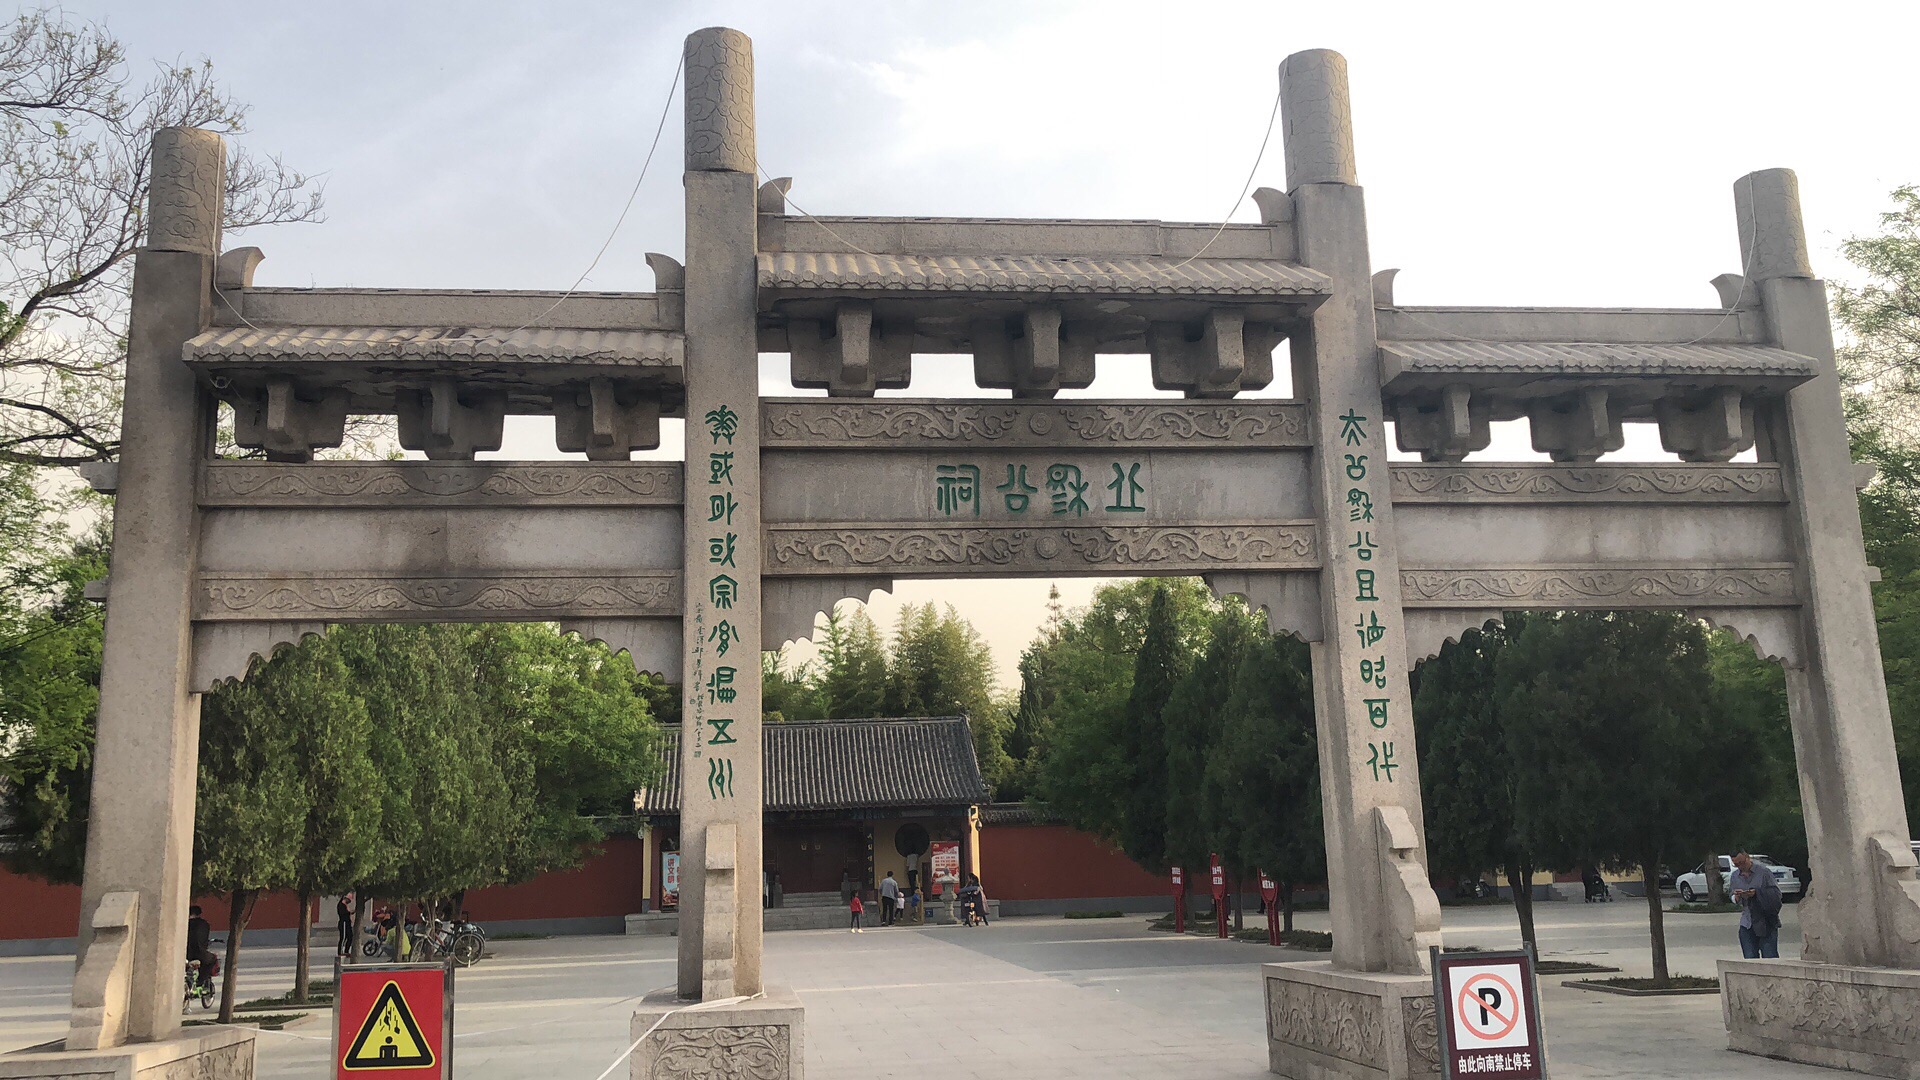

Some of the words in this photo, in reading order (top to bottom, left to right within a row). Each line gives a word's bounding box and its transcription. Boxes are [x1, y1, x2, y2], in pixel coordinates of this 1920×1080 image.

[1458, 1052, 1532, 1074] 由此向南禁止停车
